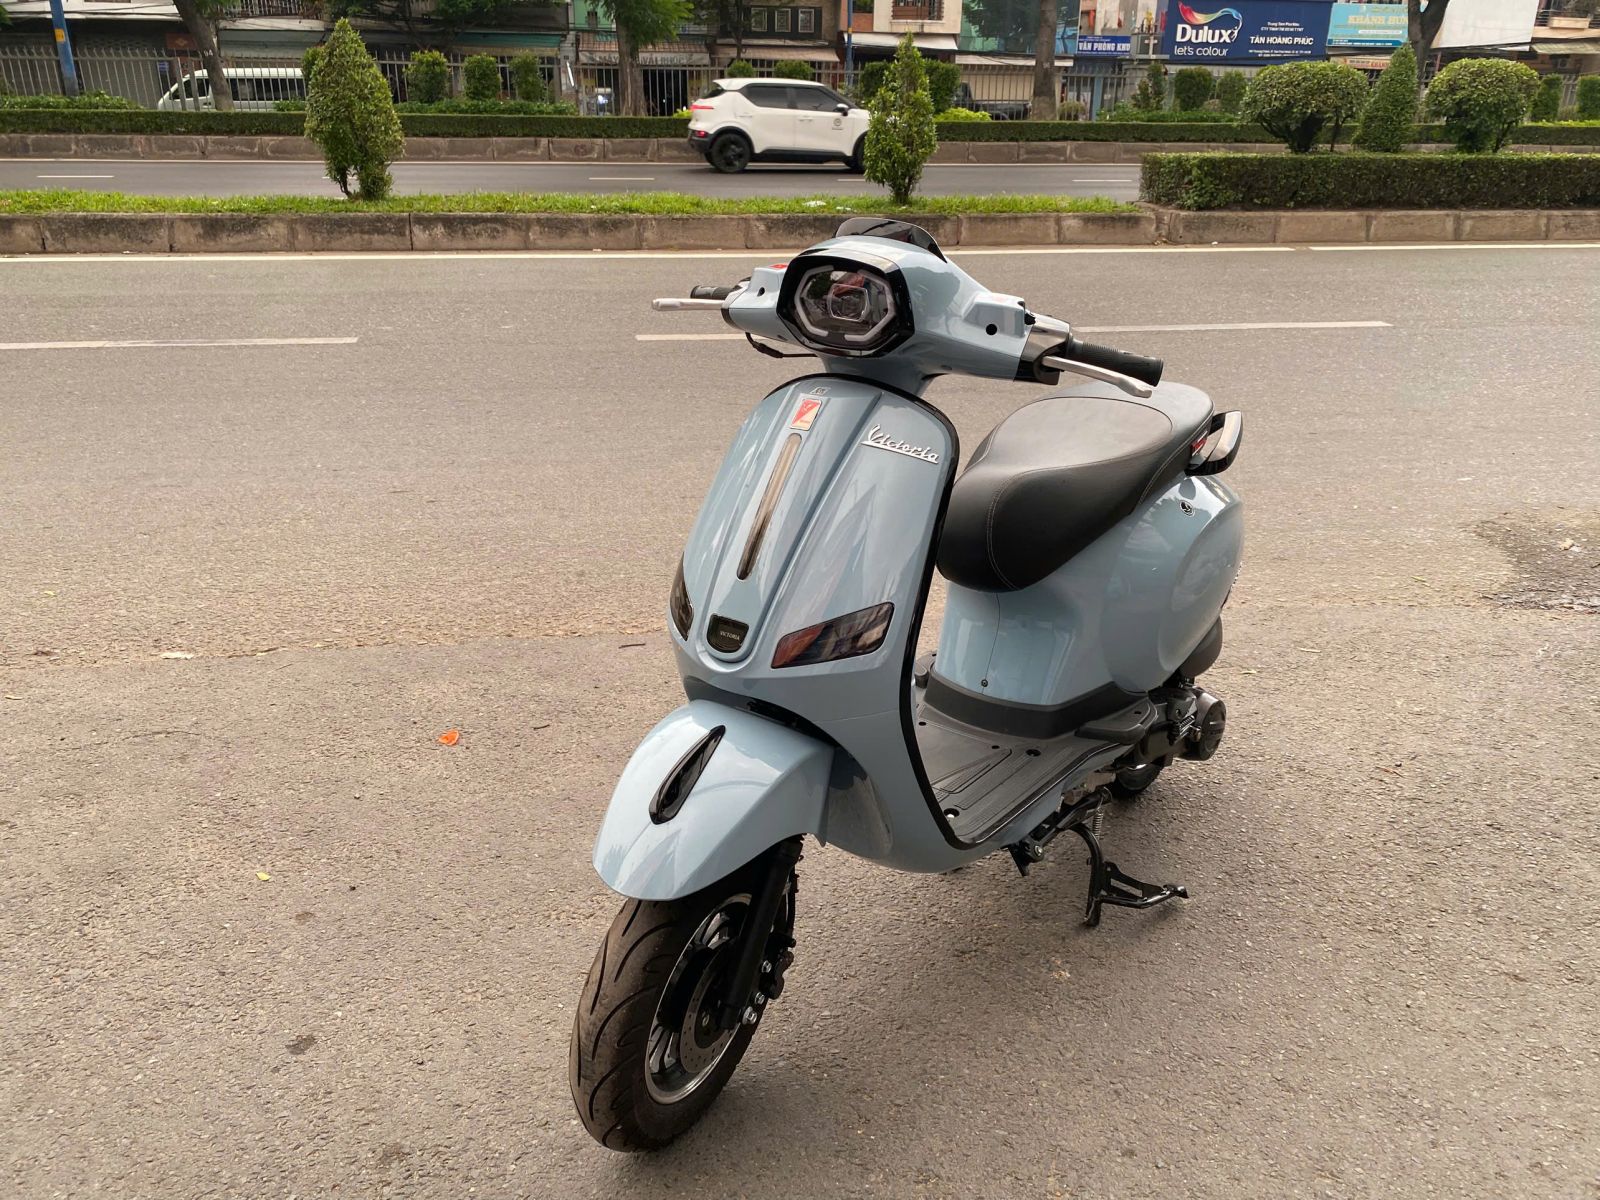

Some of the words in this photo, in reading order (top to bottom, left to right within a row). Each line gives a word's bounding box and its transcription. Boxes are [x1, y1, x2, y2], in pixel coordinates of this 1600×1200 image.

[1176, 24, 1231, 43] Dulux
[1195, 46, 1229, 57] colour
[866, 424, 939, 462] Victoria
[720, 630, 741, 641] VICTORIA
